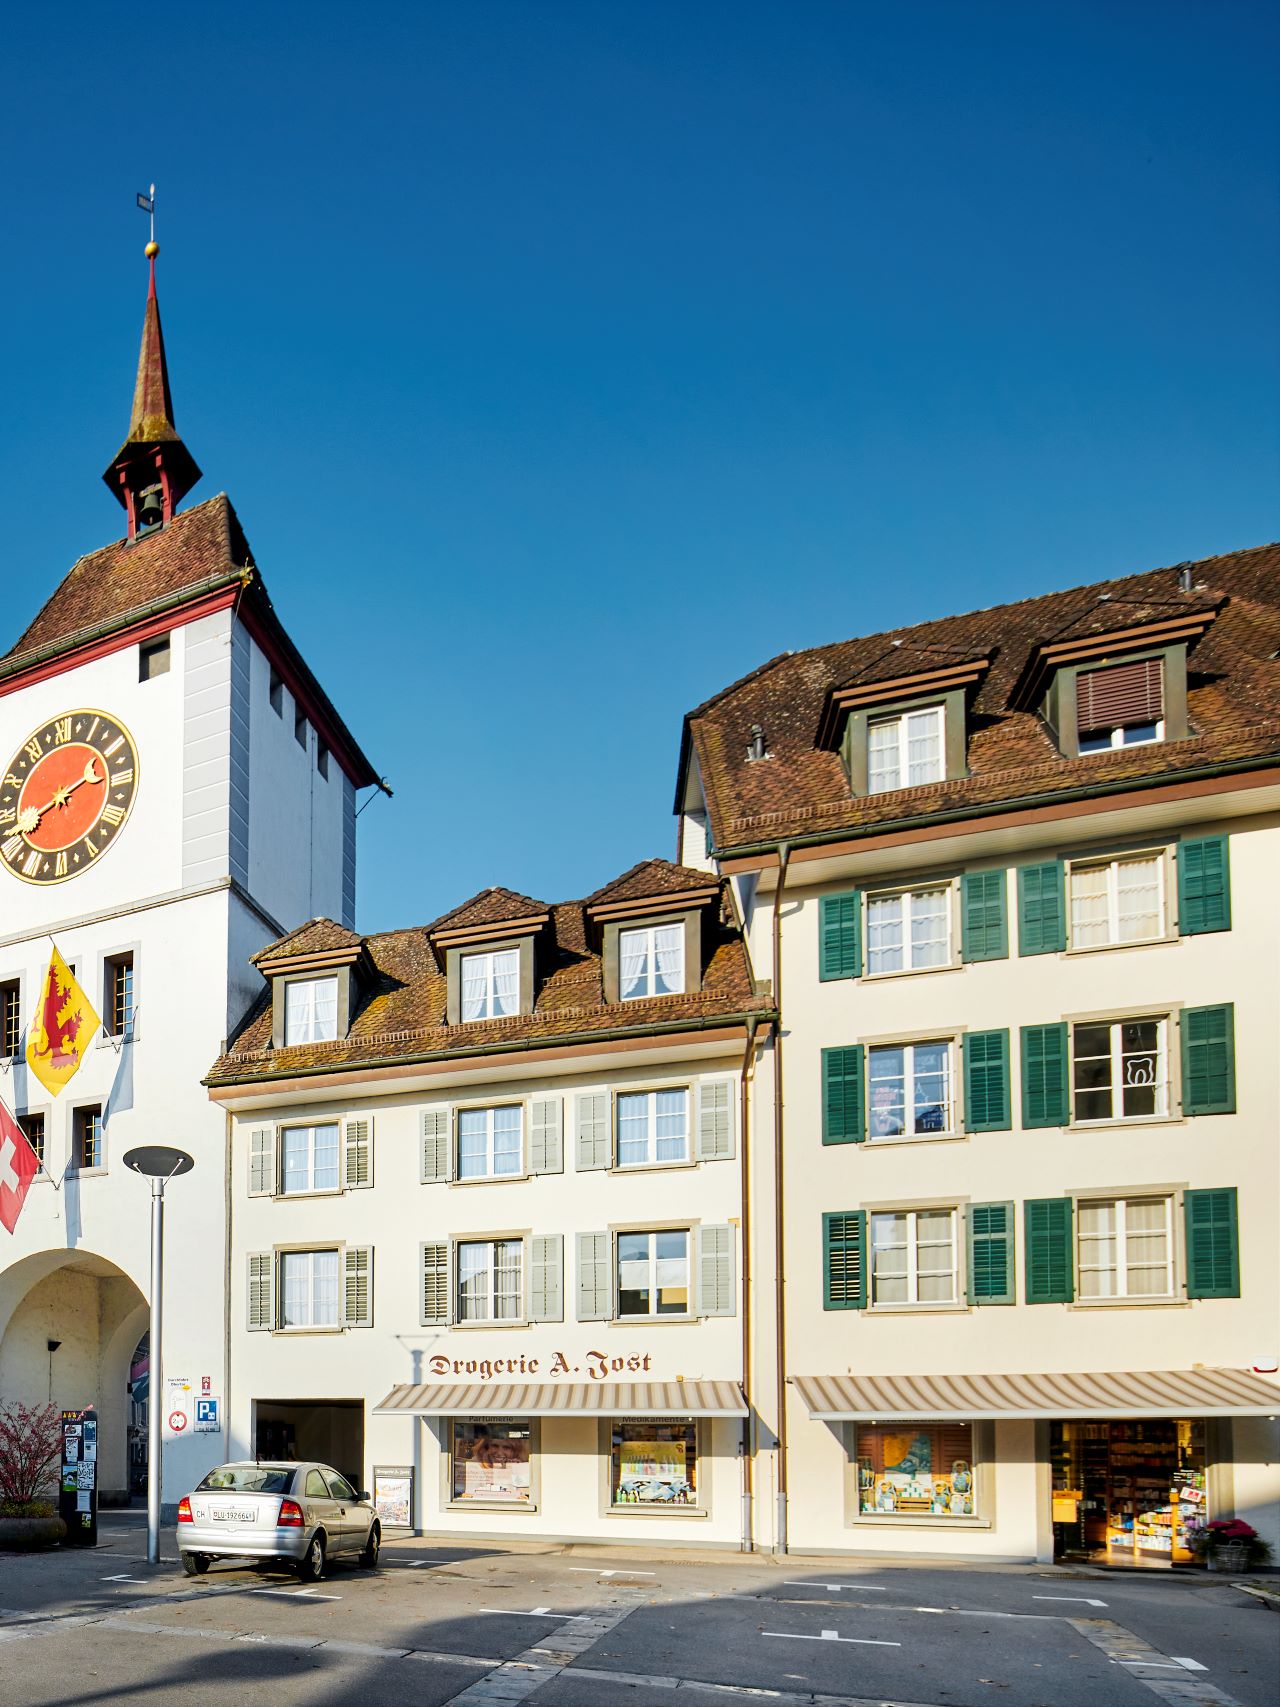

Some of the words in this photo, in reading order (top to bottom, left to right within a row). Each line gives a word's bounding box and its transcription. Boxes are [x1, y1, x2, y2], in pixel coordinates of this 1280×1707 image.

[429, 1354, 539, 1380] Drogerie
[550, 1351, 580, 1377] A.
[586, 1350, 652, 1380] Jost
[200, 1403, 209, 1418] P
[196, 1510, 205, 1518] CH
